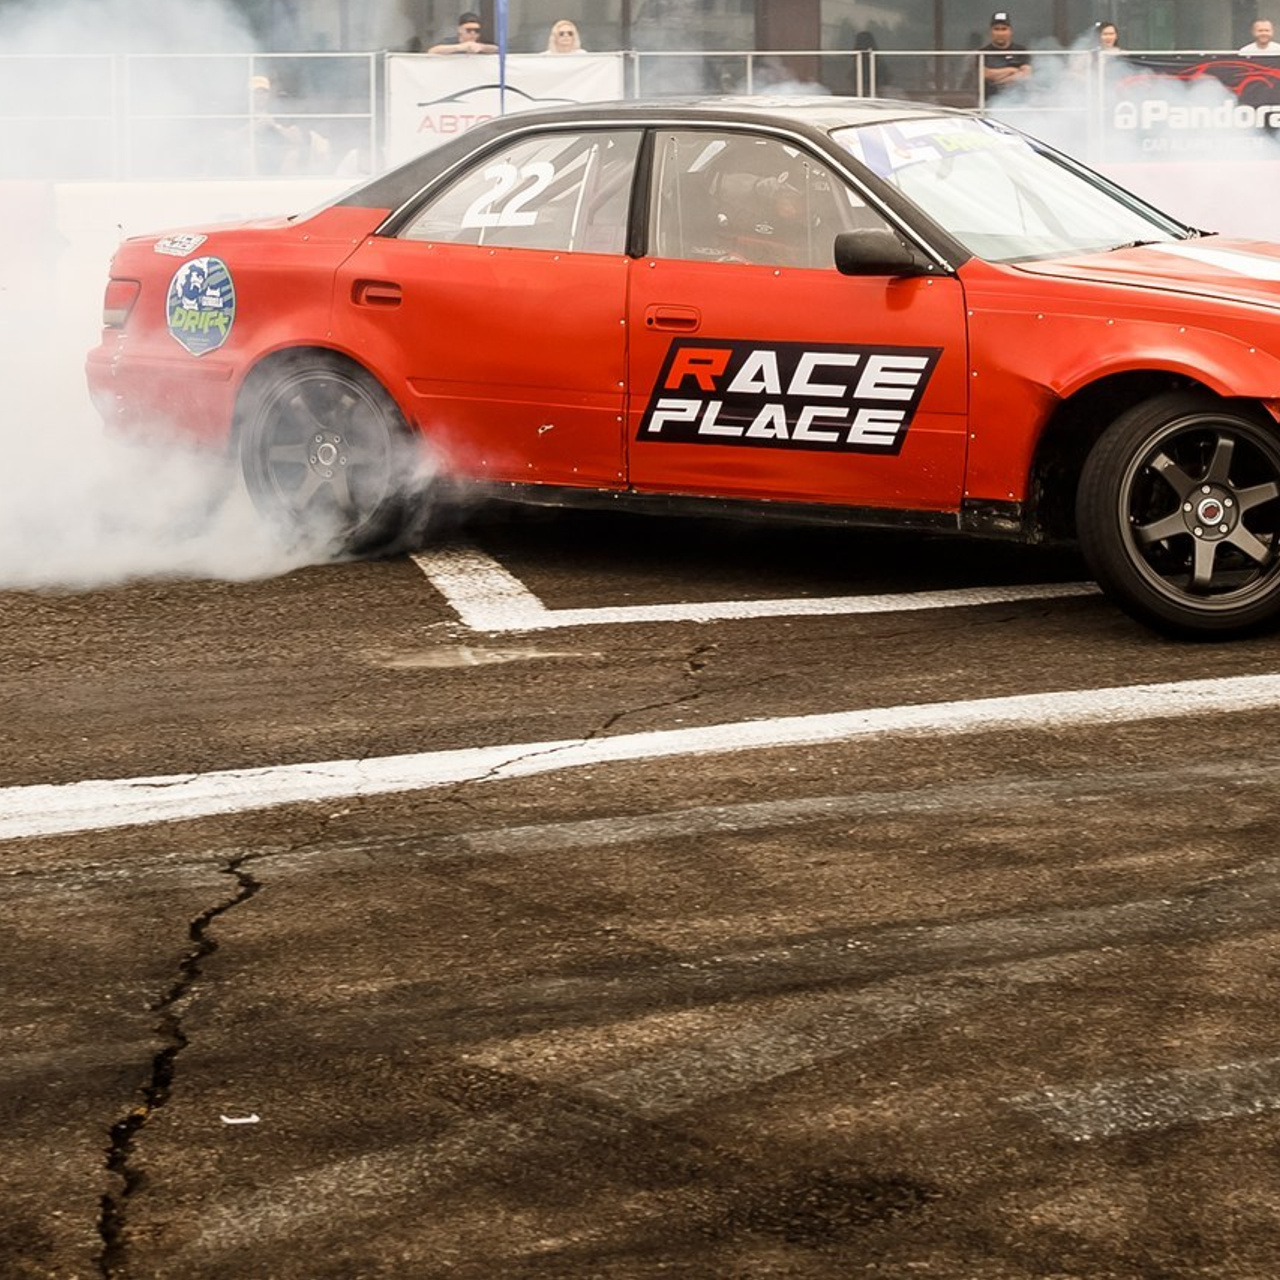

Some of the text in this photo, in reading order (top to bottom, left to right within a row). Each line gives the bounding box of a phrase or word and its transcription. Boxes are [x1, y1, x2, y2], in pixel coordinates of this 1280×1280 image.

[461, 161, 555, 228] 22
[171, 306, 230, 337] DRIFT
[664, 347, 929, 401] RACE
[648, 398, 906, 445] PLACE
